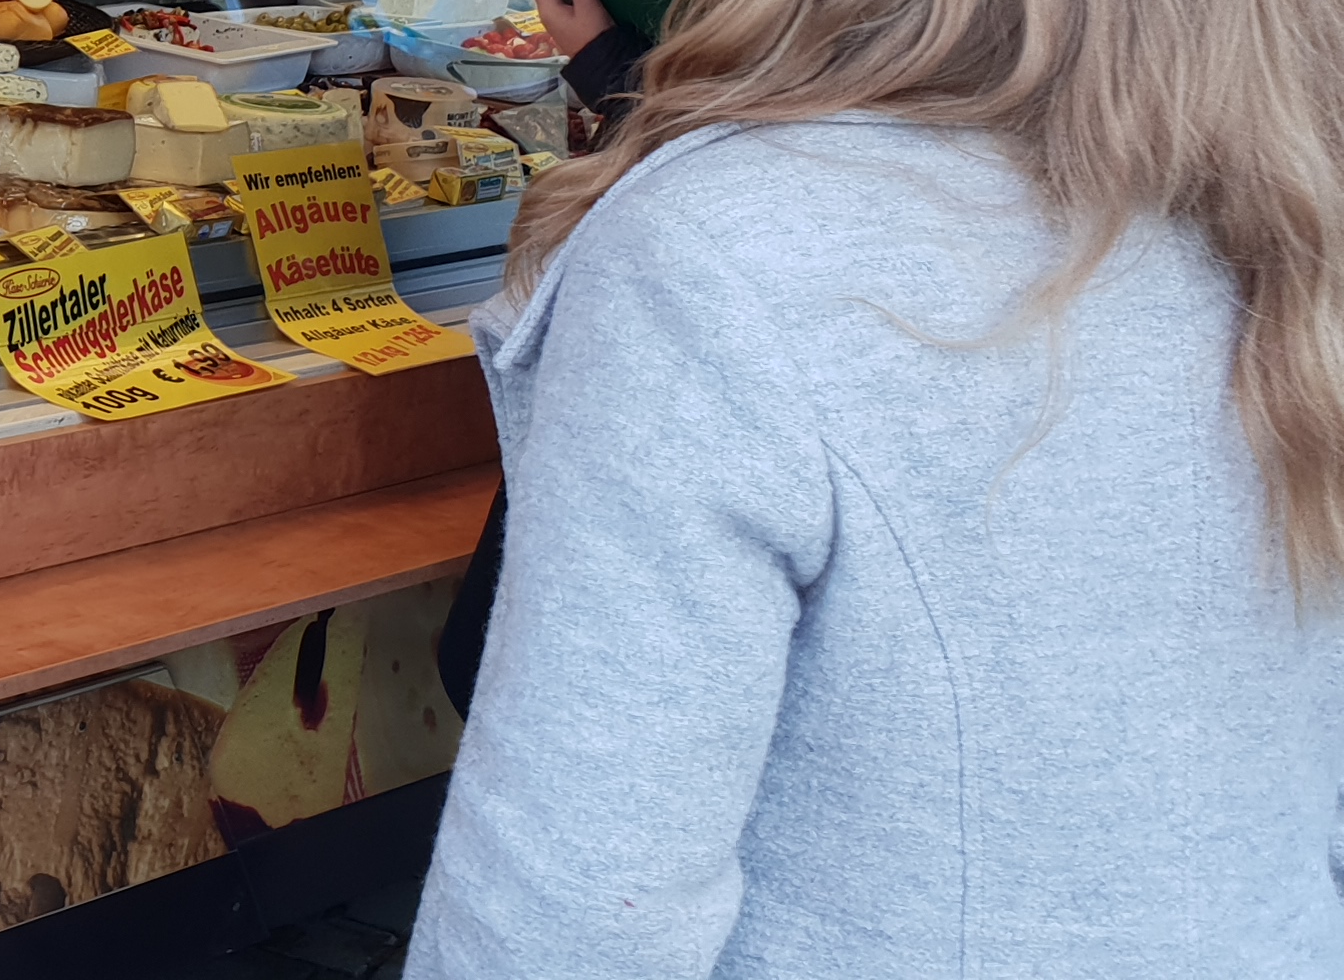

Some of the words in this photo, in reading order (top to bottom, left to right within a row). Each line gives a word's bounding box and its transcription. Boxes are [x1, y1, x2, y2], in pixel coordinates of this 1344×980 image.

[243, 173, 270, 191] Wir
[275, 163, 362, 189] empfehlen:
[255, 196, 372, 240] Allgäuer
[266, 246, 381, 293] Käsetüte
[3, 273, 107, 353] Zillertaler
[14, 265, 185, 384] Schmugglerkäse
[275, 304, 330, 324] Inhalt:
[331, 298, 343, 314] 4
[346, 293, 398, 313] Sorten
[300, 323, 369, 343] Allgäuer
[81, 386, 160, 414] 100g
[153, 367, 186, 384] €
